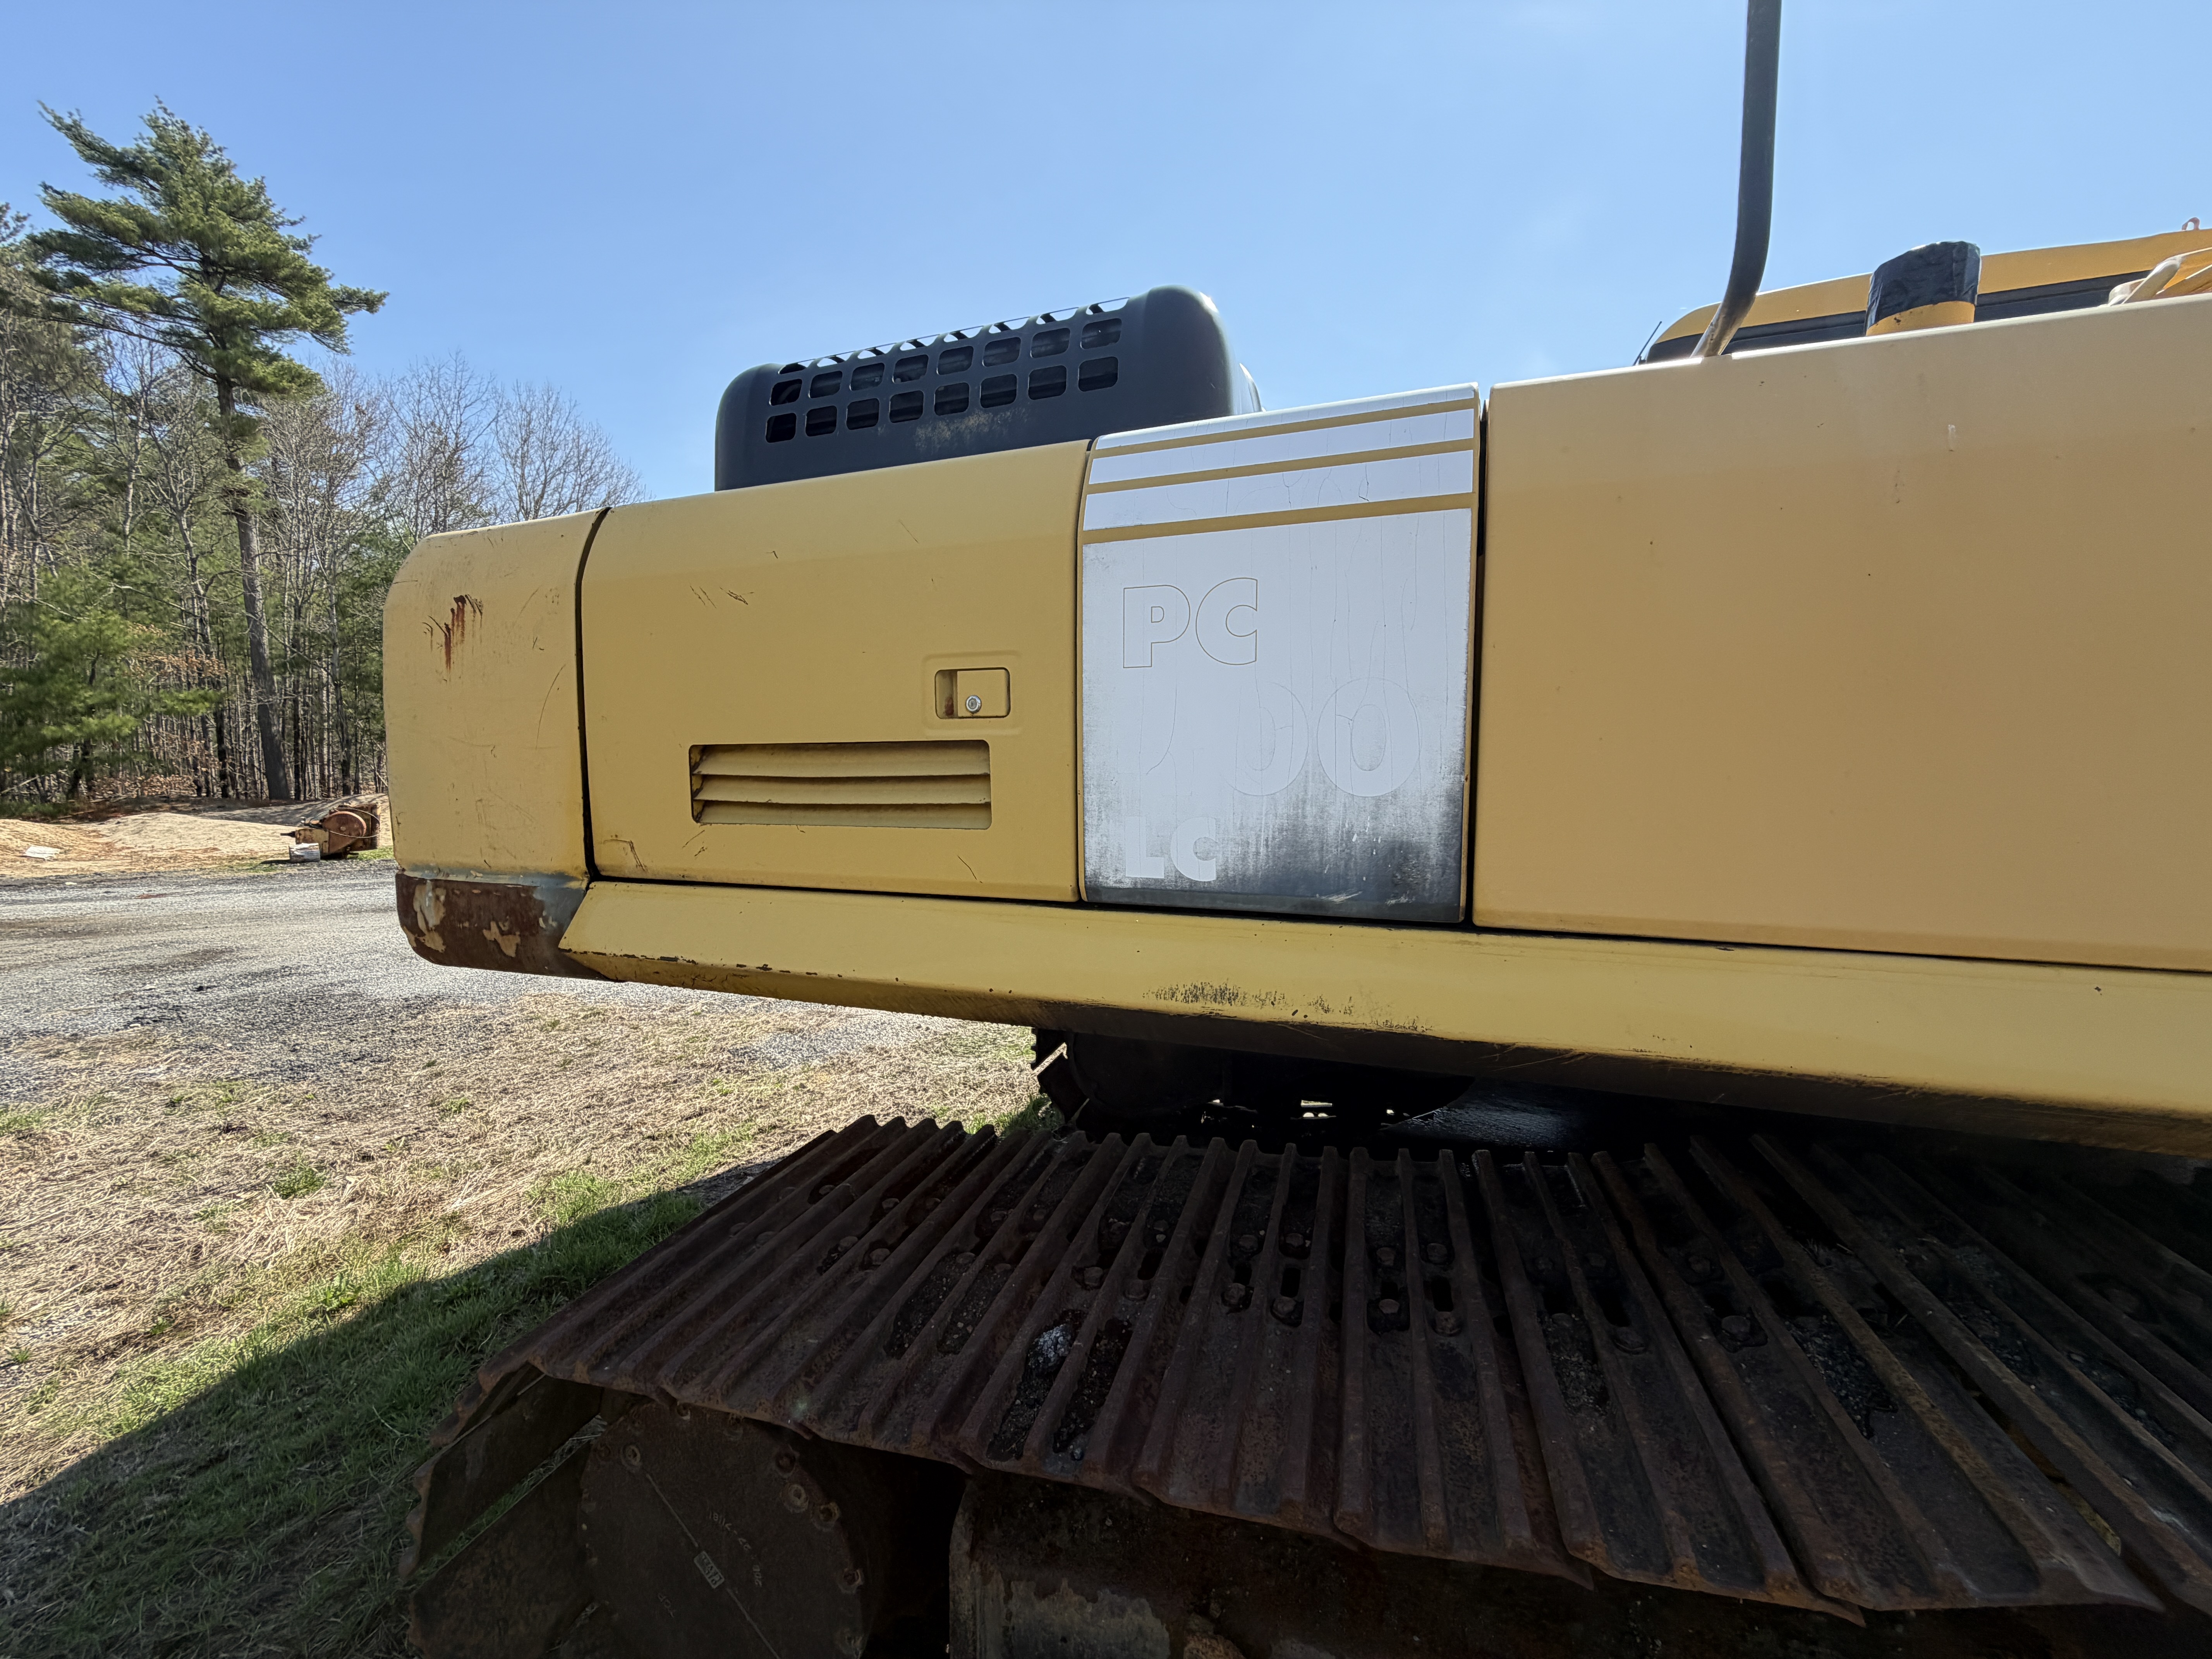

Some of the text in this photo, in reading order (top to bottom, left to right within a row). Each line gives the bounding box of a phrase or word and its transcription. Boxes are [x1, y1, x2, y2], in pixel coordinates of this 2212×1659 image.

[1123, 577, 1258, 669] PC
[1125, 816, 1217, 882] LC
[658, 1592, 676, 1618] TOP
